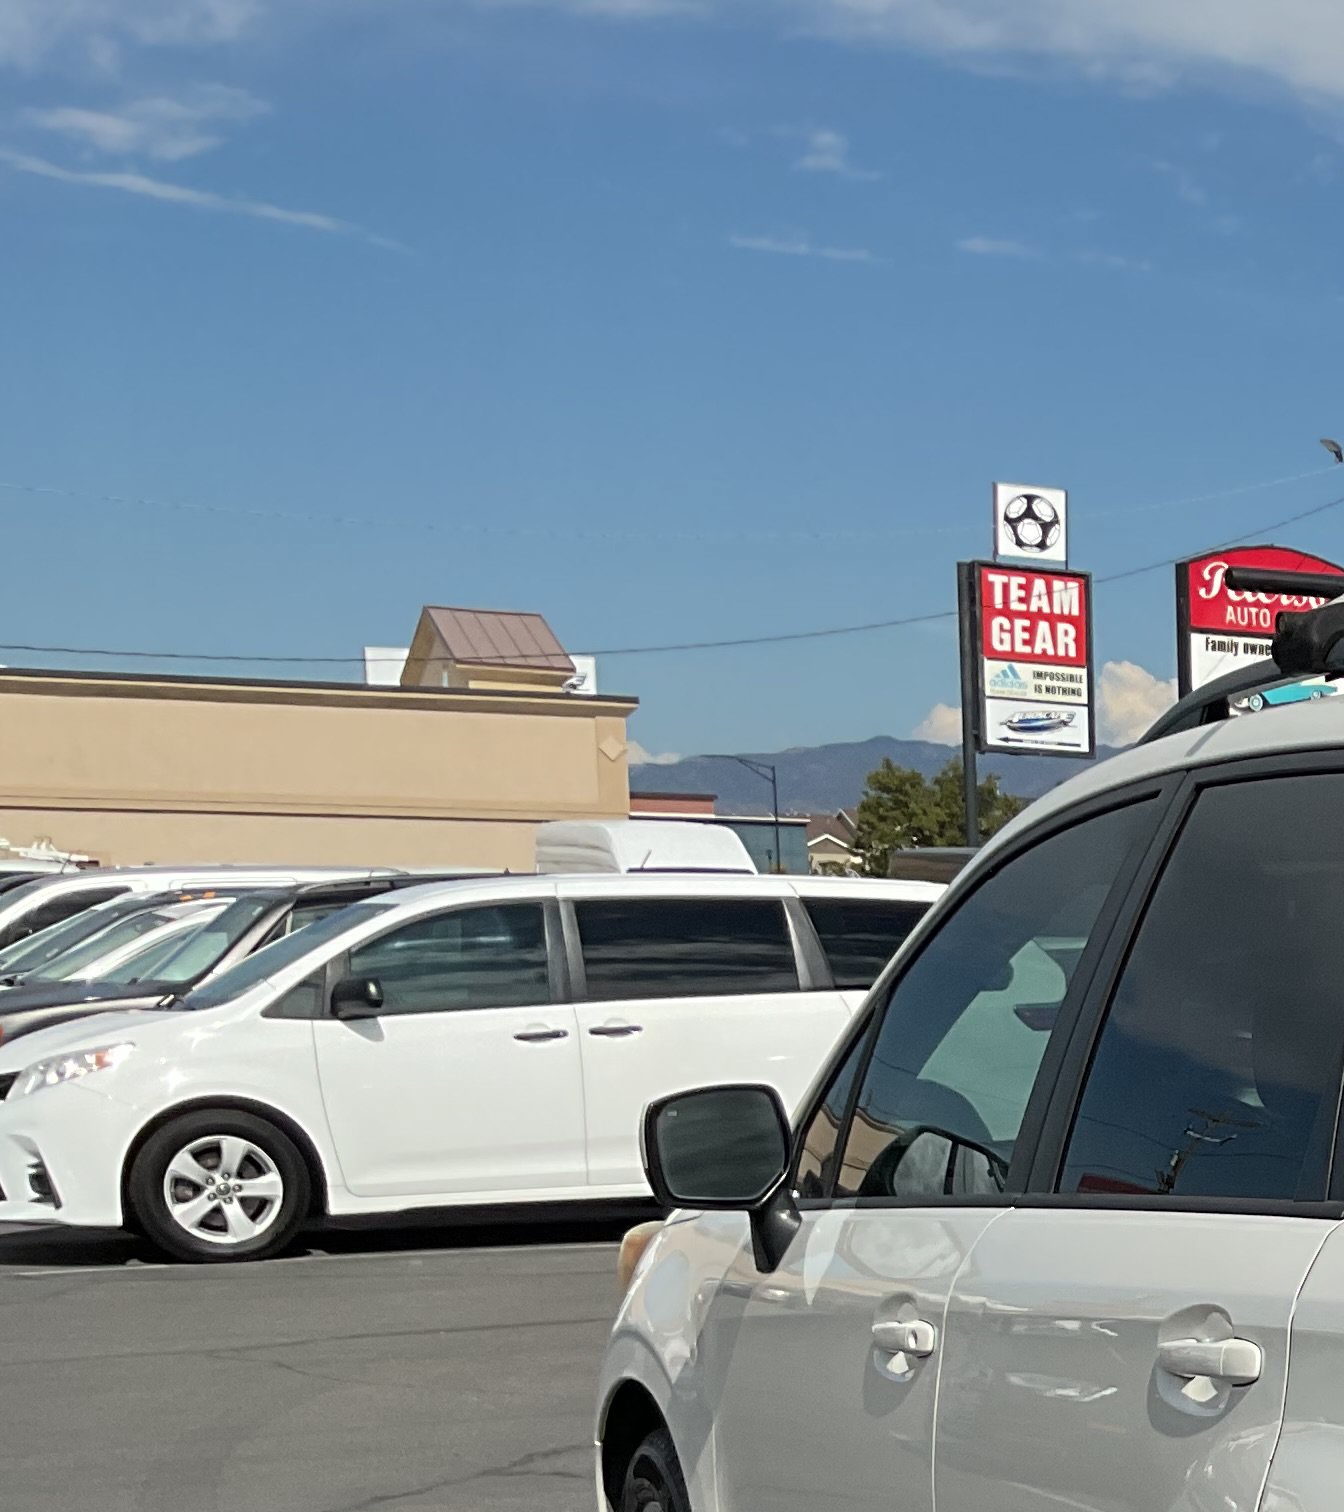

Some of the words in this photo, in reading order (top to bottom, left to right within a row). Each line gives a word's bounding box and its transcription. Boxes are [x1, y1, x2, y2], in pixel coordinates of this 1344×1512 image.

[988, 573, 1080, 616] TEAM
[1225, 606, 1271, 628] AUTO
[991, 616, 1077, 657] GEAR
[1205, 637, 1239, 656] Family
[1243, 642, 1273, 656] owne
[1032, 670, 1083, 683] IMPOSSIBLE
[1034, 684, 1043, 694] IS
[1045, 685, 1082, 697] NOTHING
